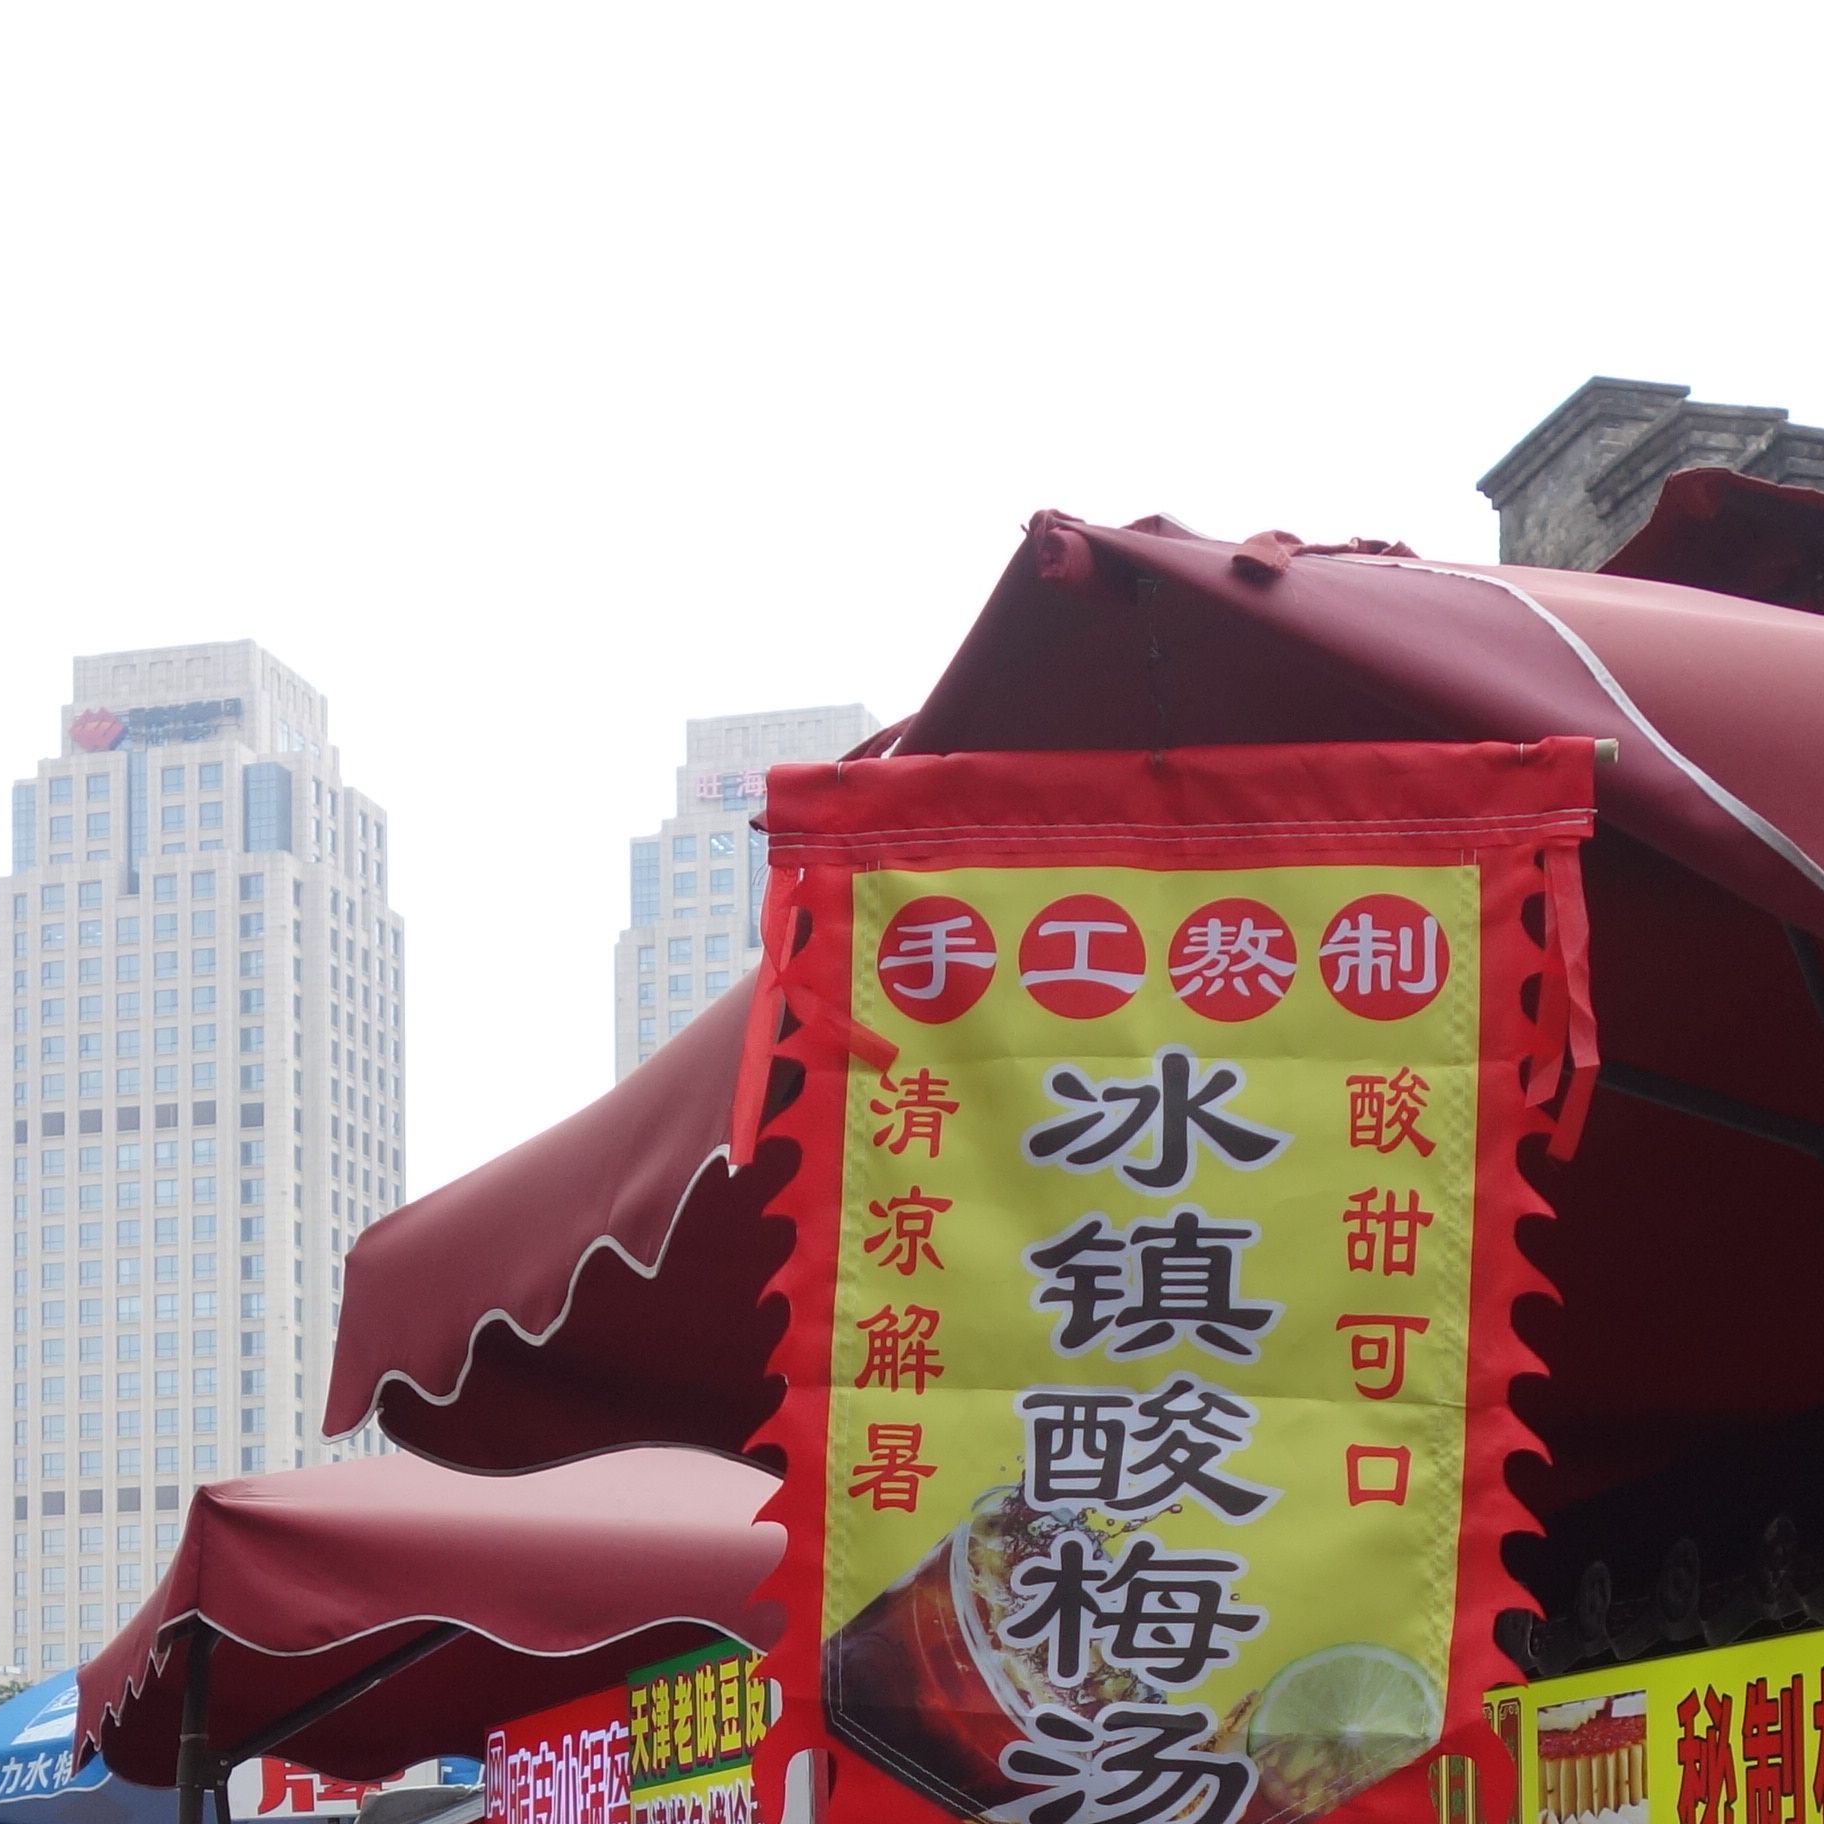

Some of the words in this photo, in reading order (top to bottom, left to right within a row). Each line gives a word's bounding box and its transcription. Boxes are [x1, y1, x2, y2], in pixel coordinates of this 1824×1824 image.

[880, 910, 1440, 1000] 手工熬制
[848, 1066, 959, 1515] 清凉解暑
[1342, 1070, 1438, 1508] 酸甜可口
[630, 1652, 768, 1786] 天津老味豆皮
